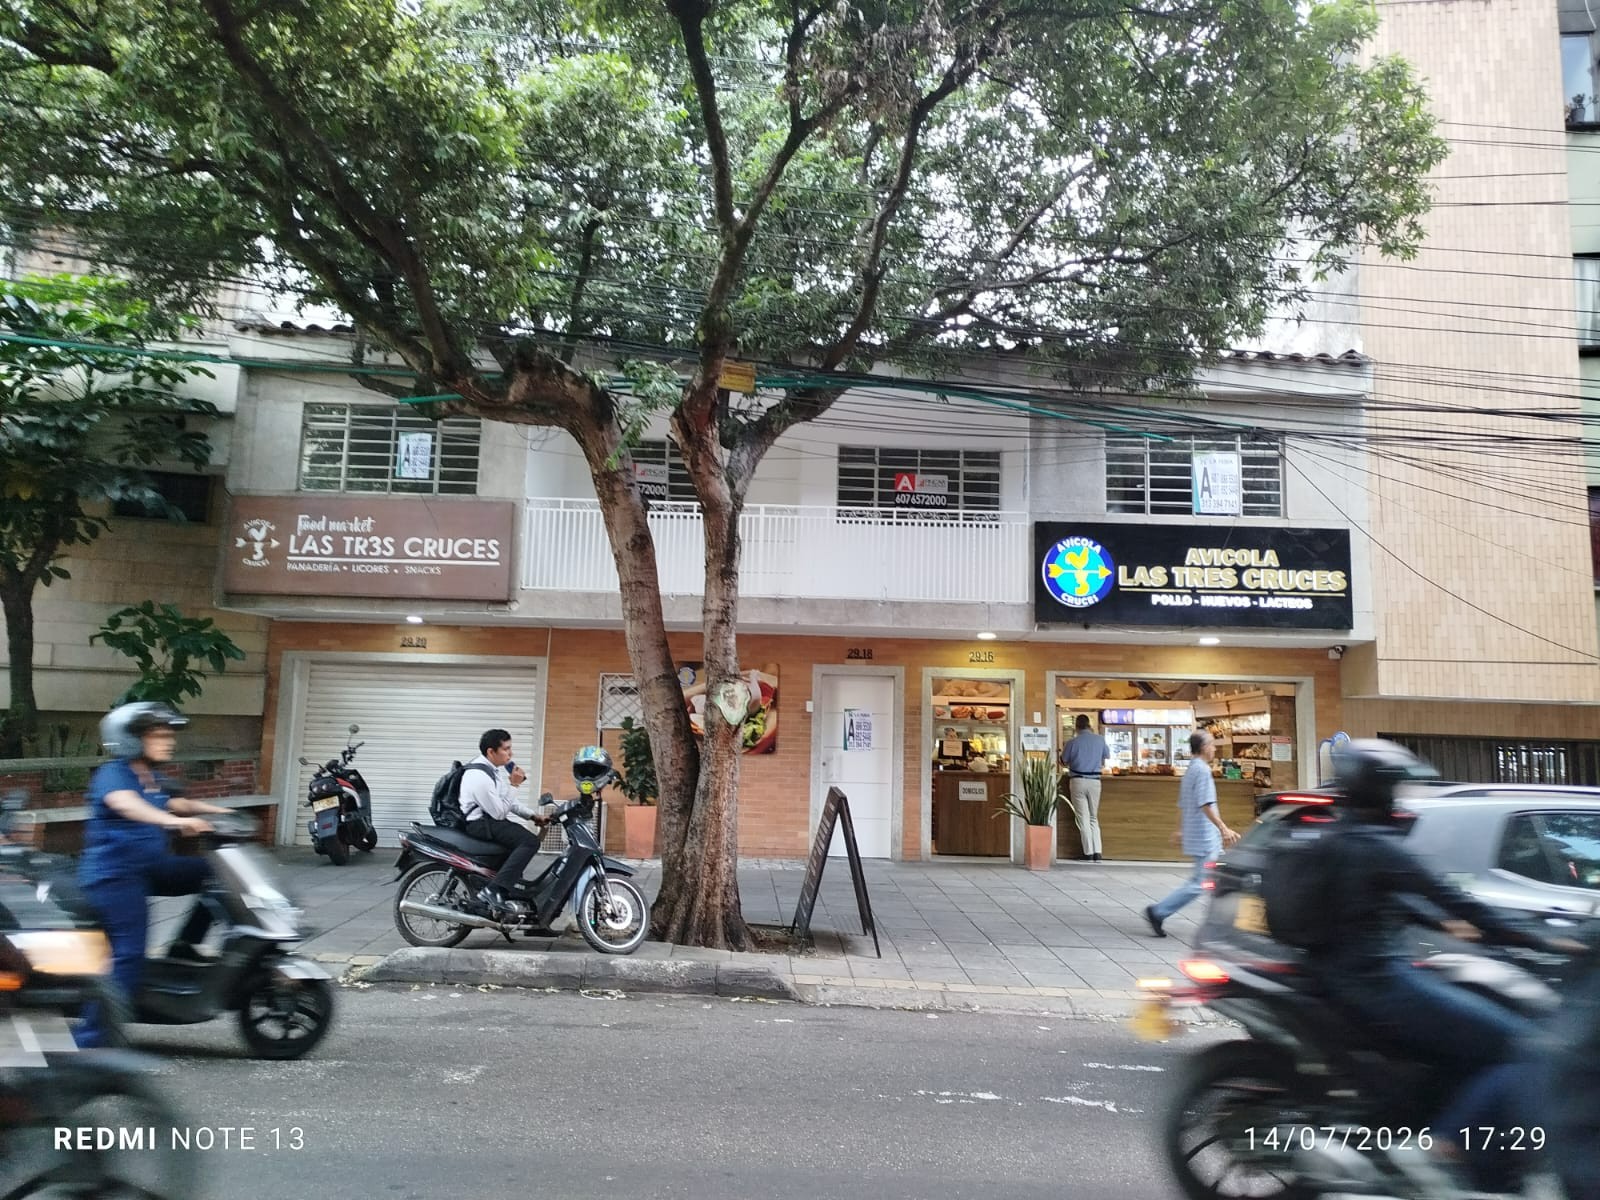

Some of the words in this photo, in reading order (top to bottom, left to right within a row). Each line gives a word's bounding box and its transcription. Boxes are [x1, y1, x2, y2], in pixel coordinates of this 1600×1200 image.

[896, 475, 915, 491] A
[1200, 466, 1213, 499] A
[297, 514, 327, 536] Food
[328, 516, 376, 533] market
[289, 534, 334, 555] LAS
[342, 535, 396, 557] TR3S
[403, 537, 500, 560] CRUCES
[1056, 536, 1102, 554] AVICOLA
[1185, 547, 1280, 567] AVICOLA
[351, 563, 390, 574] LICORES
[404, 565, 442, 575] SNACKS
[1118, 565, 1168, 587] LAS
[1171, 566, 1239, 589] TRES
[1242, 568, 1348, 592] CRUCES
[1151, 594, 1193, 606] POLLO
[847, 718, 855, 741] A
